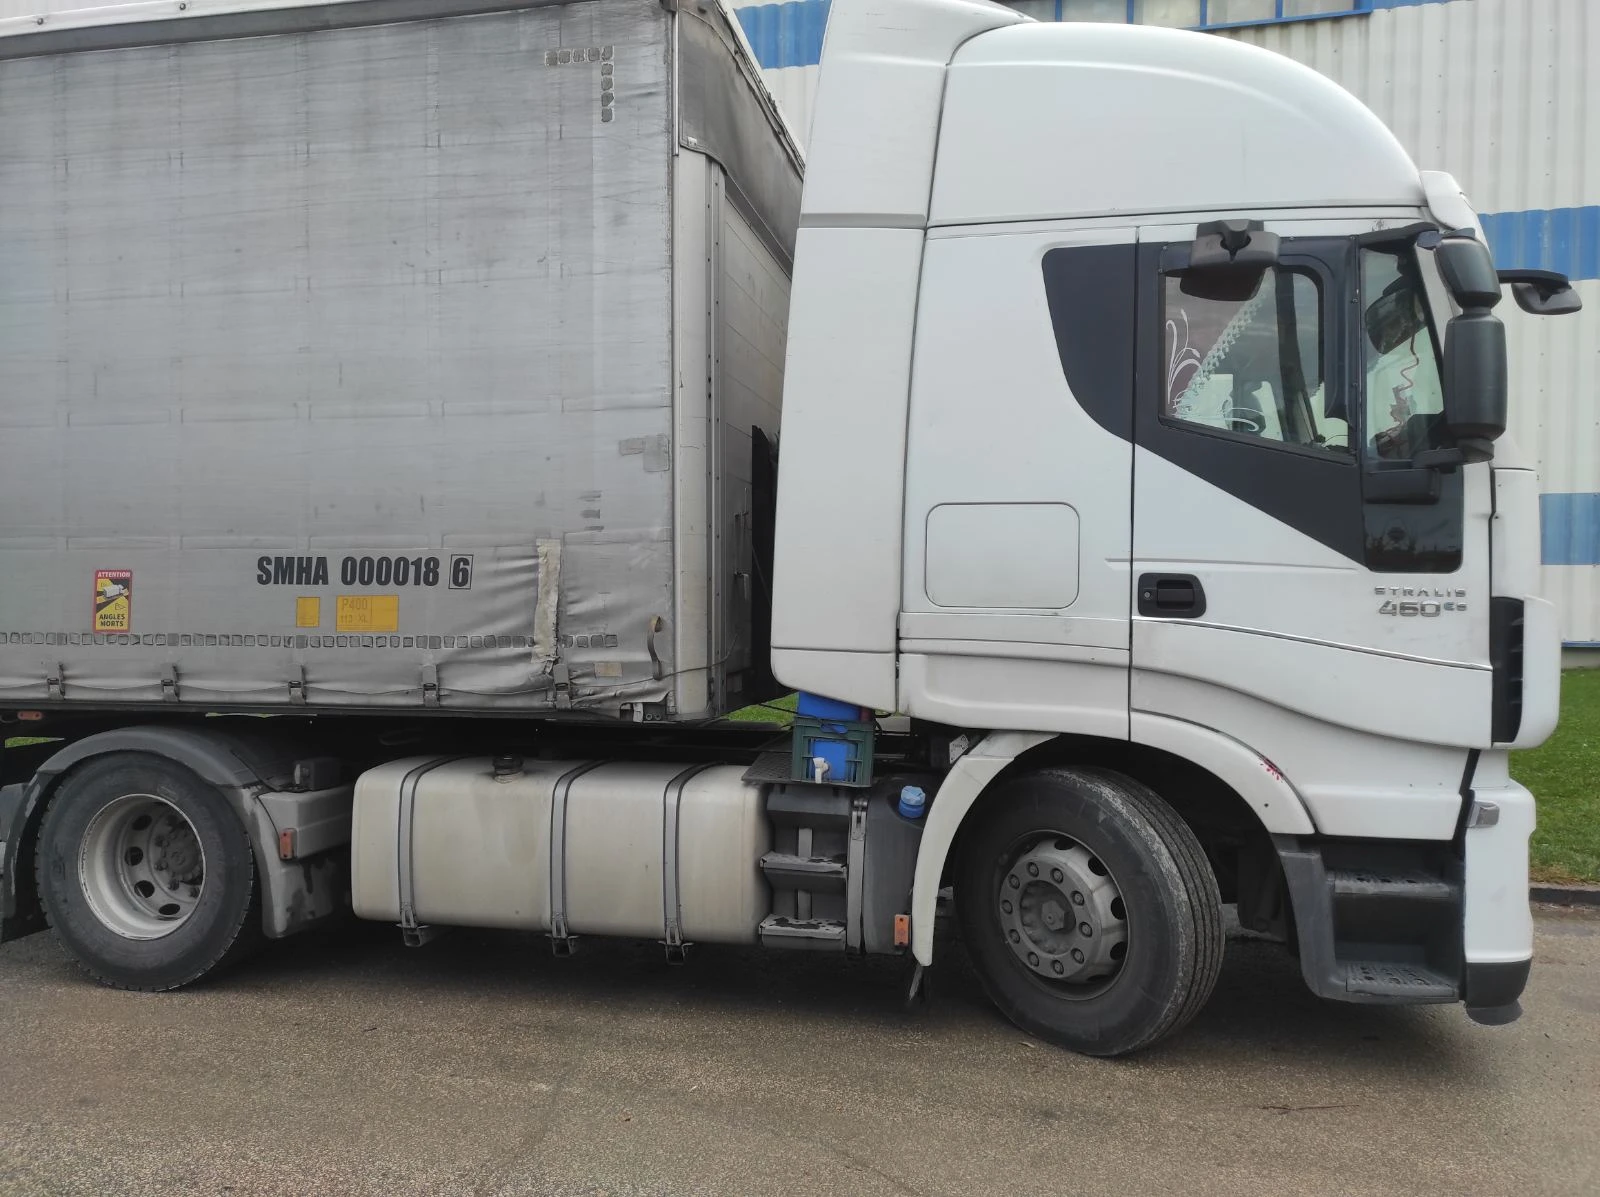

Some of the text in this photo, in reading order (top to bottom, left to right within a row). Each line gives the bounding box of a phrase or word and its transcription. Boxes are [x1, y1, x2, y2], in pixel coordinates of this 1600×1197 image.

[256, 555, 471, 588] SMHA 000018 6
[1374, 586, 1466, 598] STRALIS
[1379, 600, 1441, 618] 460
